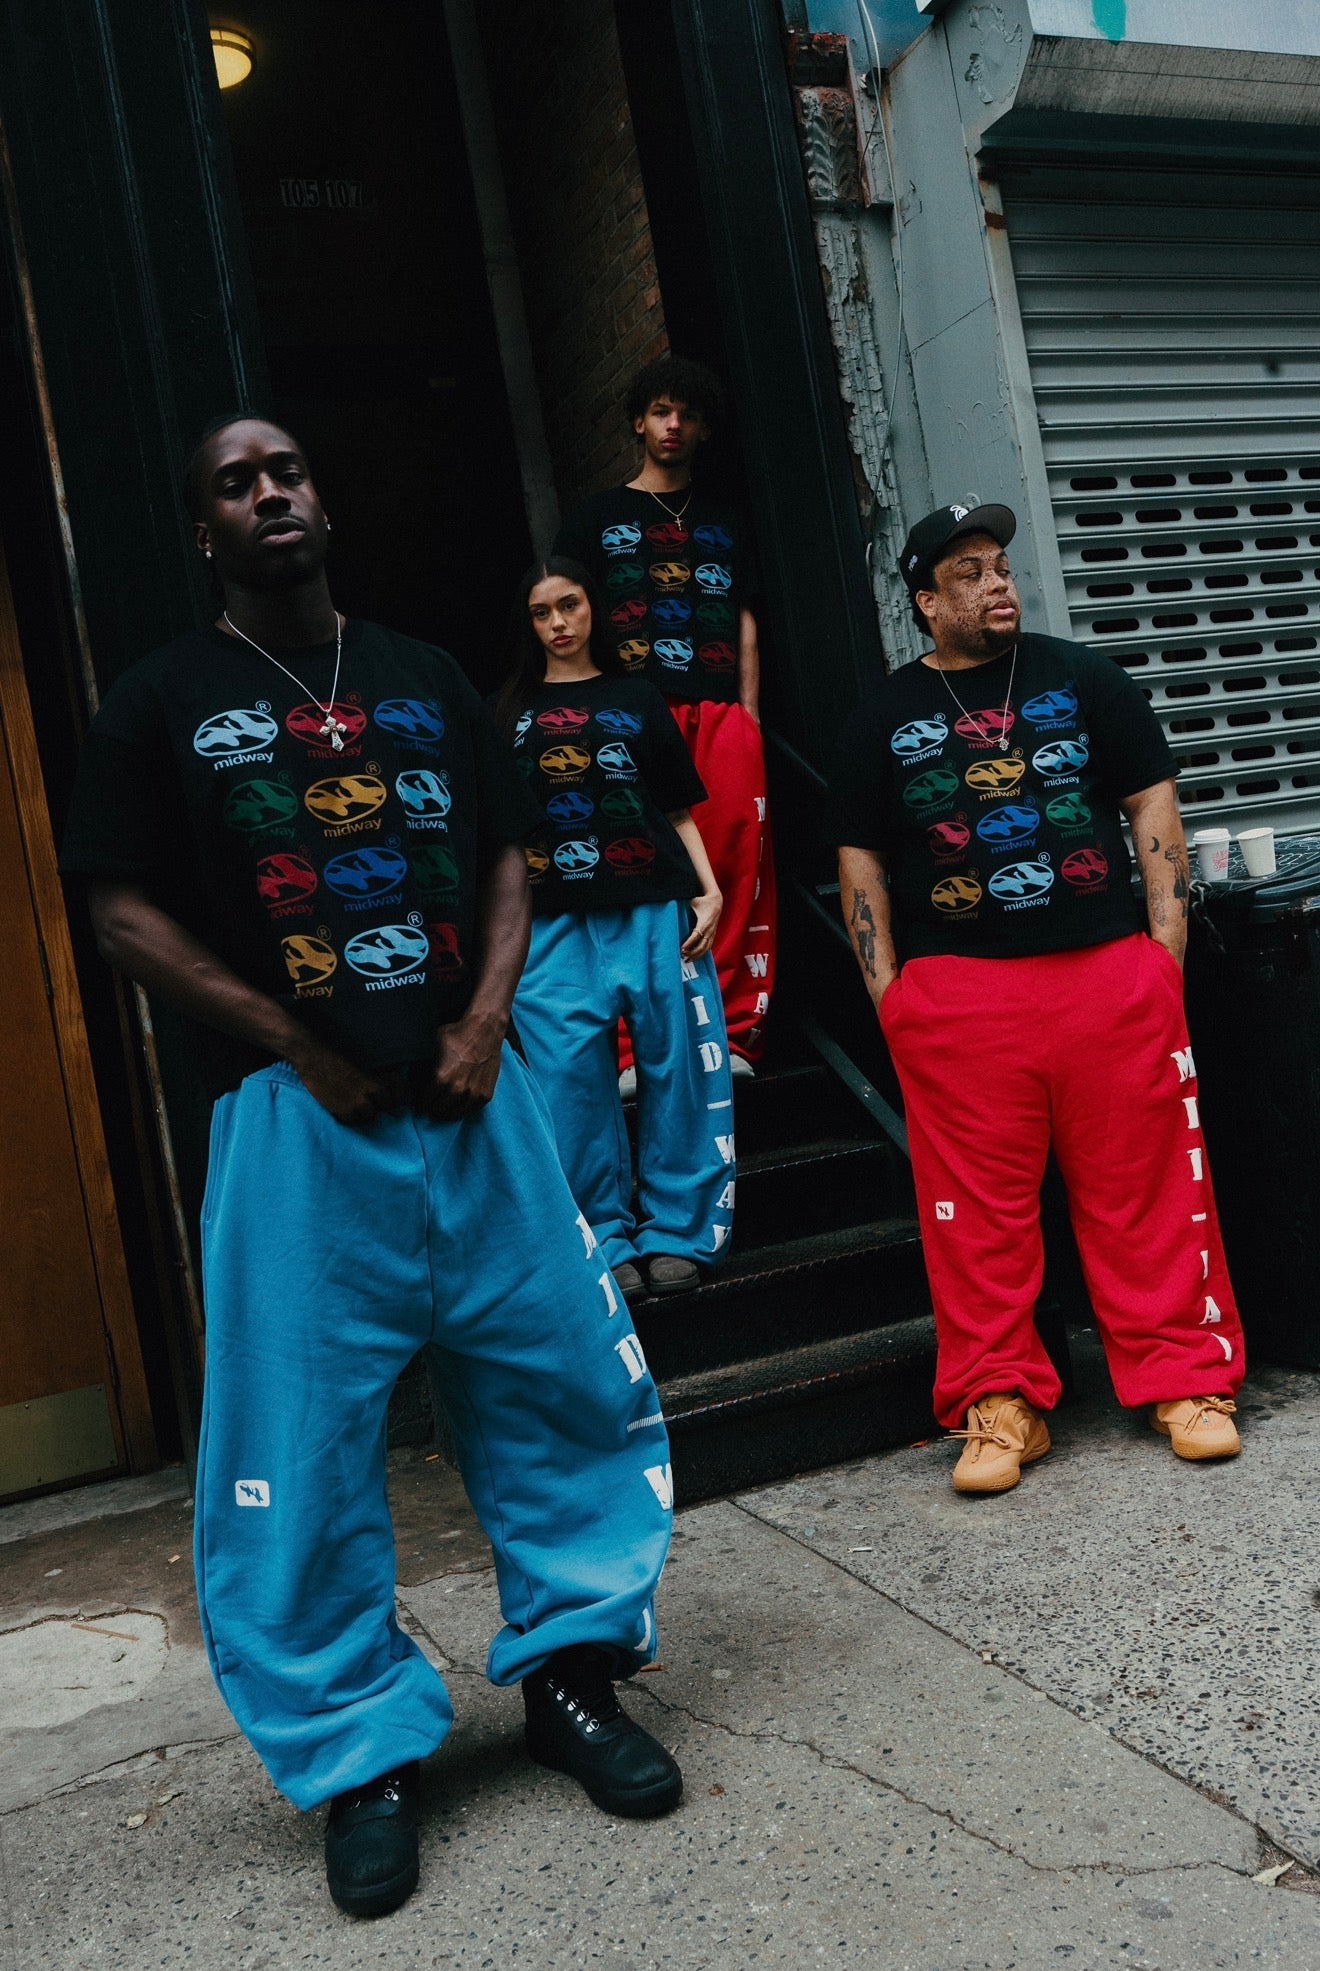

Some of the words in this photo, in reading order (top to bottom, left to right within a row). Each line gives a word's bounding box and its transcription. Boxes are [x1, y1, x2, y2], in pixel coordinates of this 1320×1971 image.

[608, 547, 637, 558] midway
[701, 588, 728, 598] midway
[661, 661, 689, 672] midway
[543, 728, 582, 737] midway
[306, 745, 363, 760] midway
[902, 746, 944, 768] midway
[213, 751, 275, 772] midway
[549, 775, 586, 786] midway
[605, 772, 639, 784] midway
[1043, 774, 1081, 789] midway
[978, 786, 1021, 803] midway
[916, 800, 956, 820] midway
[323, 818, 382, 839] midway
[1060, 827, 1095, 841] midway
[990, 837, 1036, 855] midway
[562, 870, 595, 881] midway
[1075, 884, 1110, 898] midway
[343, 892, 404, 913] midway
[1003, 896, 1051, 914] midway
[365, 970, 427, 993] midway
